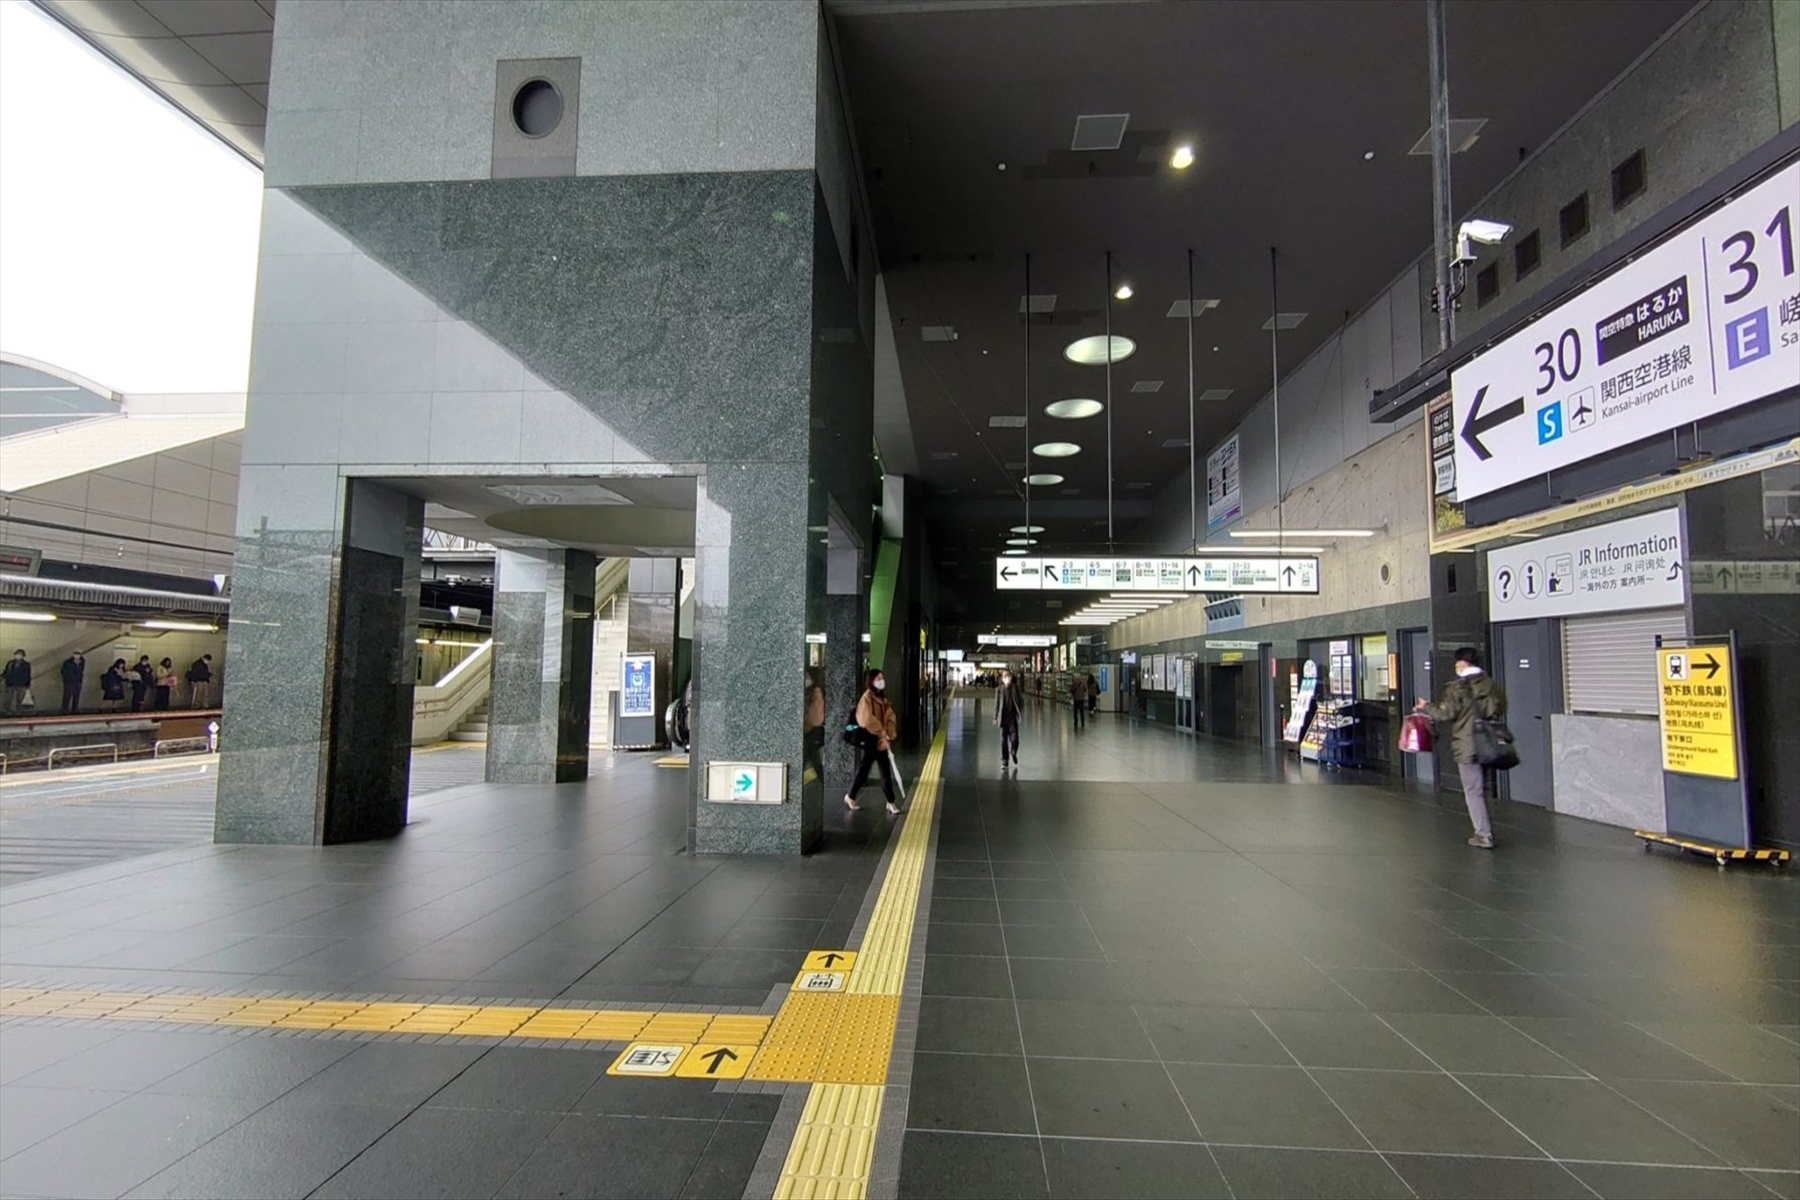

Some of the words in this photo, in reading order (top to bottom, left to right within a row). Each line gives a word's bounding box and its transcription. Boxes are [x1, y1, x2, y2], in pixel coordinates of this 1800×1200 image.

[1721, 204, 1795, 305] 31
[1636, 286, 1683, 322] はるか
[1638, 308, 1683, 341] HARUKA
[1736, 318, 1760, 361] E
[1535, 328, 1581, 396] 30
[1600, 344, 1693, 404] 関西空港線
[1602, 383, 1670, 419] Kansai-airport
[1671, 374, 1695, 392] Line
[1543, 408, 1556, 439] S
[1578, 549, 1592, 567] JR
[1594, 535, 1678, 563] Information
[1623, 562, 1633, 573] JR
[1634, 556, 1666, 573] 问询处
[1580, 569, 1589, 580] JR
[1590, 565, 1616, 579] 안내소
